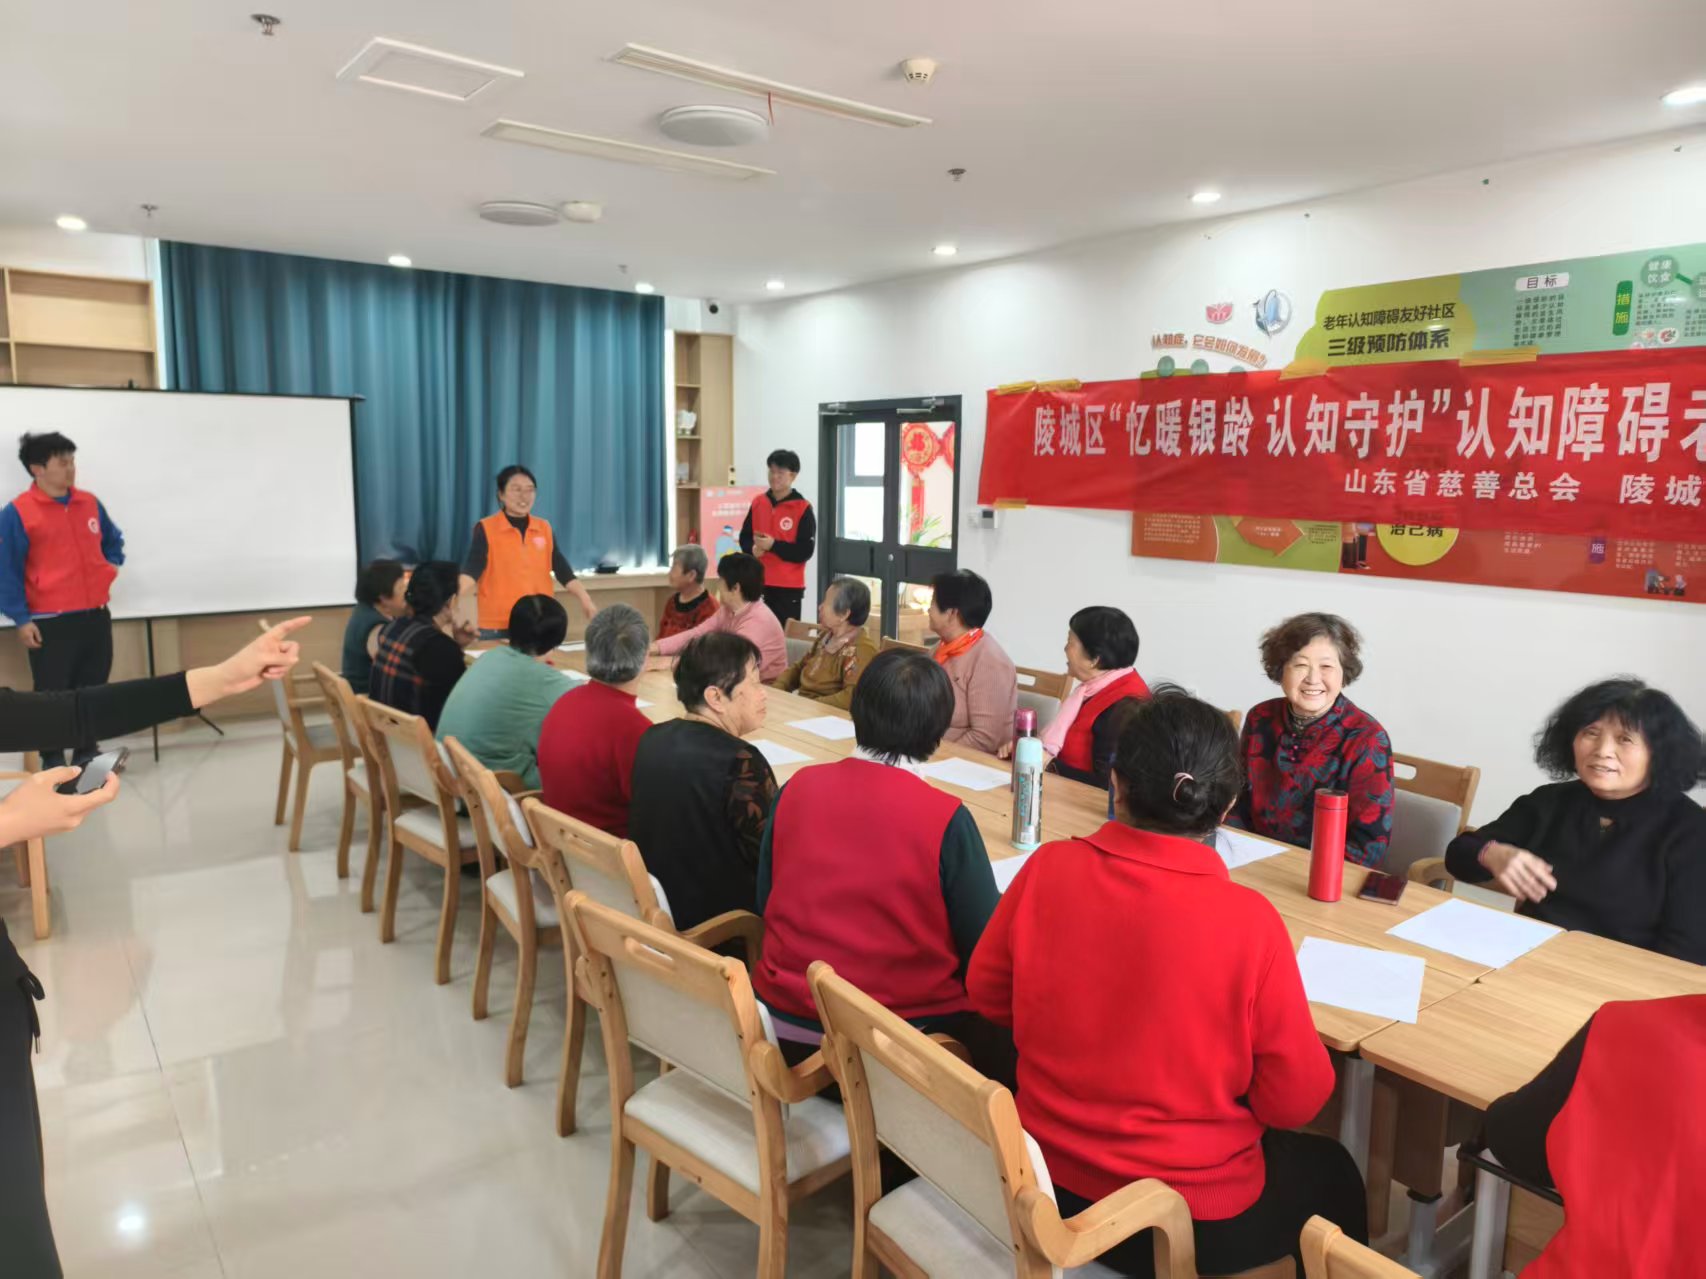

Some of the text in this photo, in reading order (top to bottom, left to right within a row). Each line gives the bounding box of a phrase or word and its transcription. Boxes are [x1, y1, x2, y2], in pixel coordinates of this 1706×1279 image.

[1527, 275, 1558, 289] 目标
[1323, 302, 1456, 331] 老年认知障碍友好社区
[1327, 328, 1450, 357] 三级预防体系
[1344, 468, 1702, 506] 山东省慈善总会 陵城
